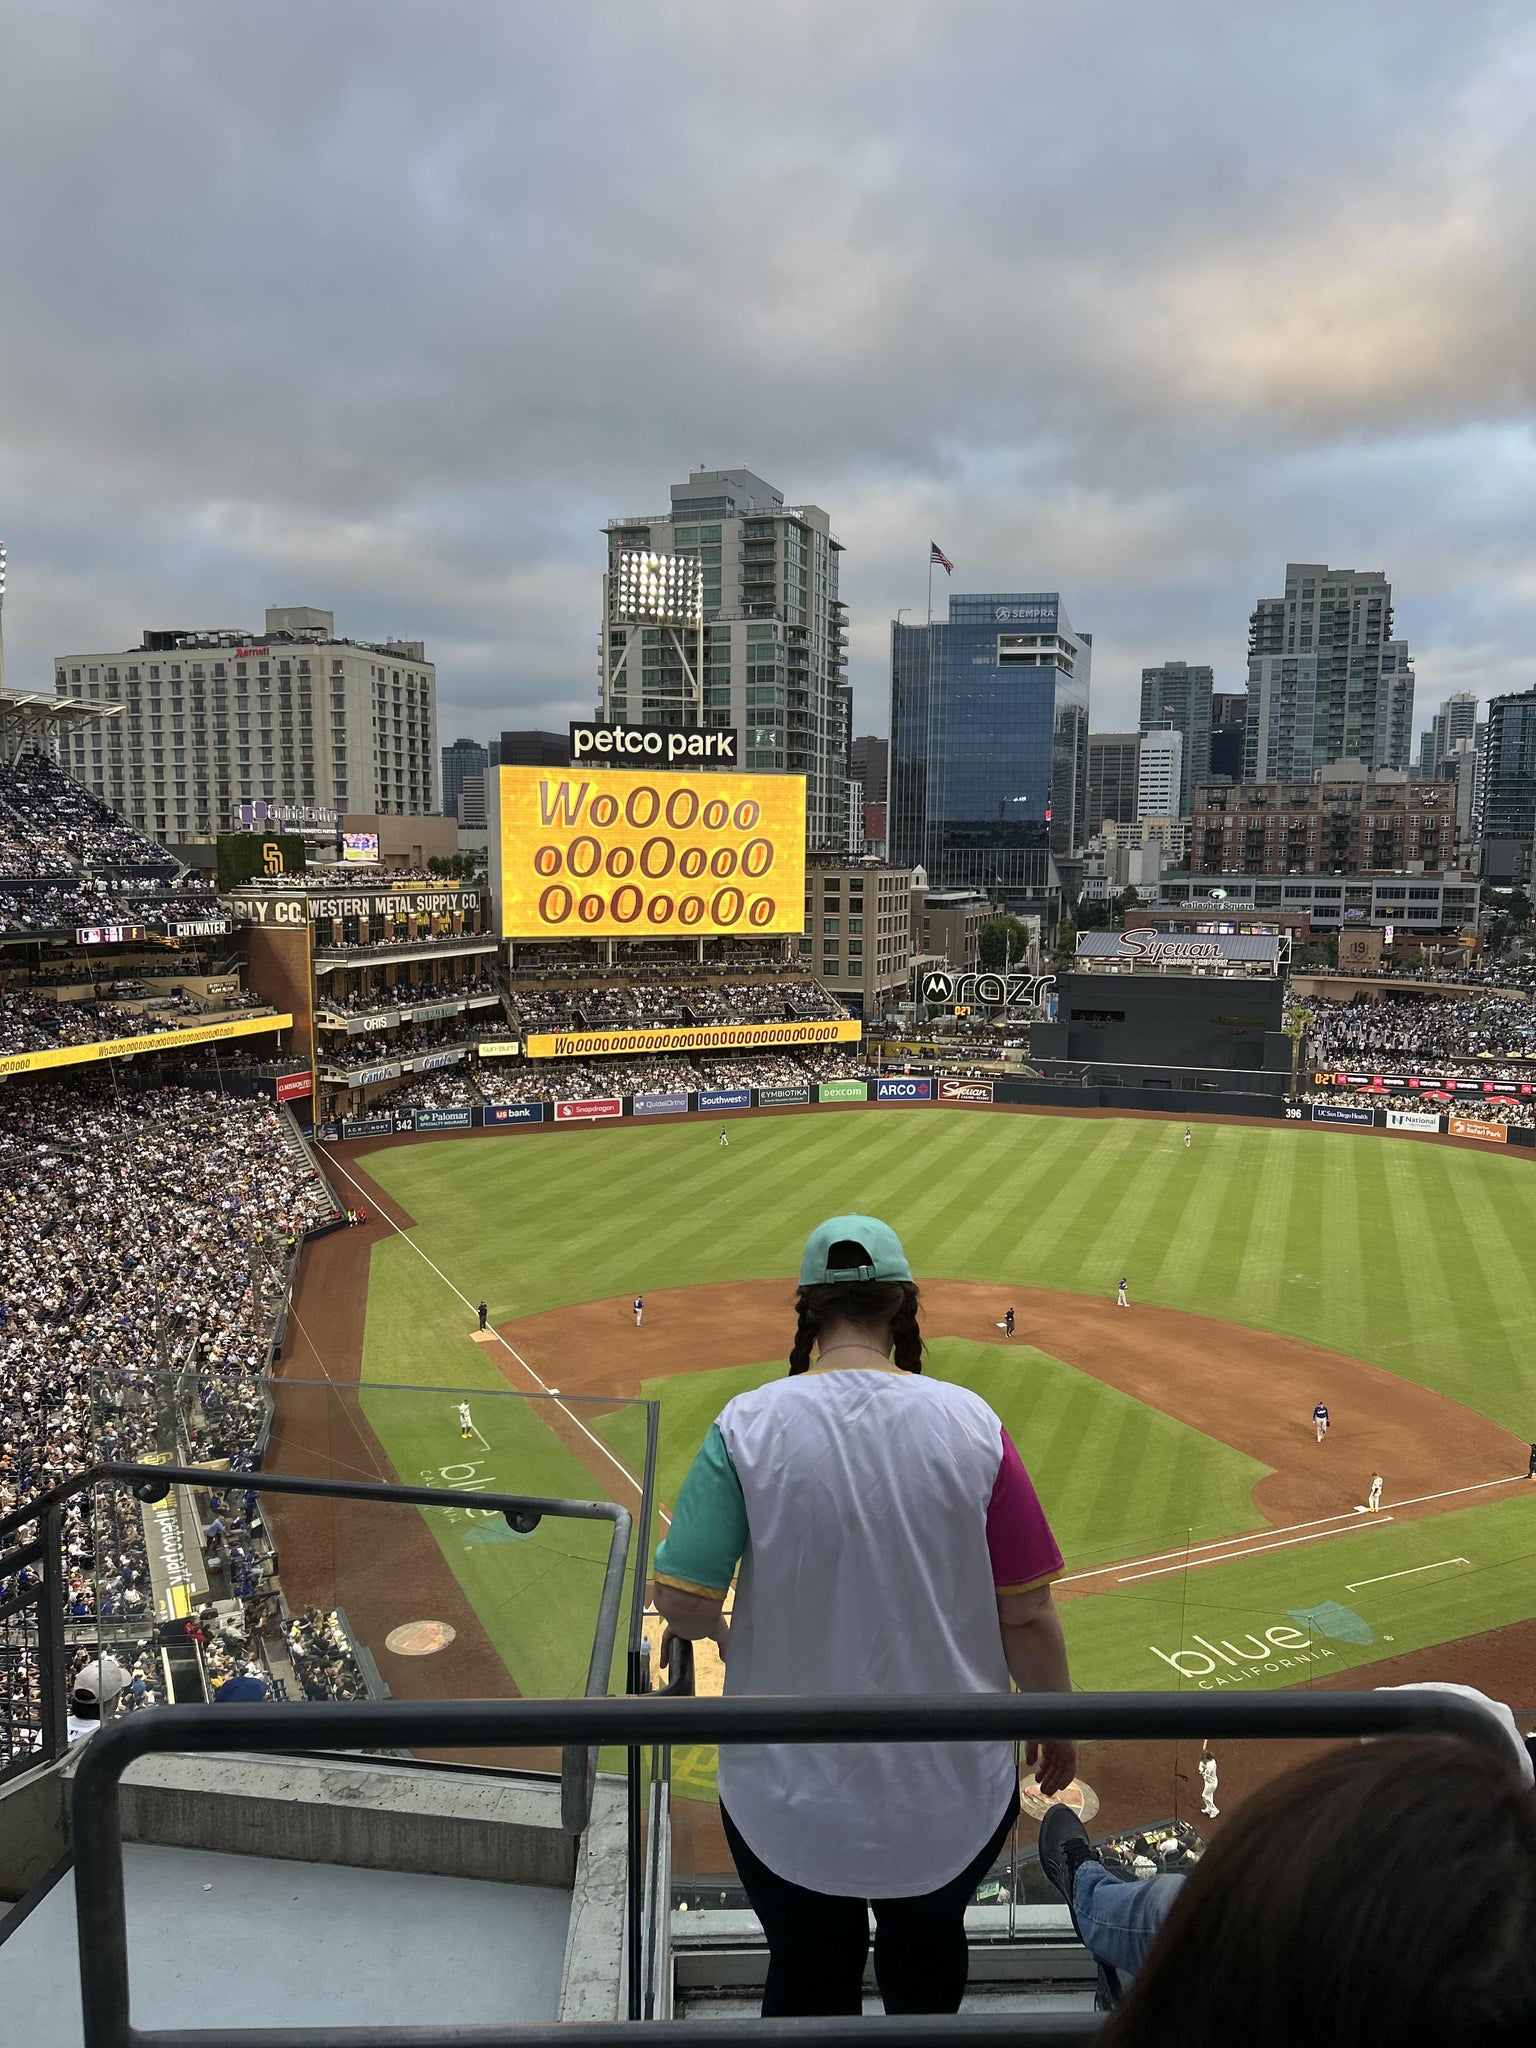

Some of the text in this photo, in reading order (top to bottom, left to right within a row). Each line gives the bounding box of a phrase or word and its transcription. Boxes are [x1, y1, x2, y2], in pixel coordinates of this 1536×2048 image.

[1012, 609, 1055, 618] SEMPRA
[573, 725, 735, 761] petco park
[309, 893, 479, 918] WESTERN METAL SUPPLY CO.
[1180, 901, 1255, 911] Gallagher Square
[176, 921, 226, 936] CUTWATER
[1117, 928, 1224, 965] Sycuan
[1354, 942, 1366, 953] 19
[956, 972, 1056, 1006] razr
[364, 1016, 387, 1030] ORIS
[422, 1053, 452, 1070] Canel's
[359, 1066, 393, 1084] Canel's
[1315, 1073, 1335, 1084] 0:27
[761, 1089, 807, 1099] CYMBIOTIKA
[879, 1083, 917, 1096] ARCO
[942, 1081, 988, 1099] Sycuan
[646, 1099, 685, 1109] QuidelOrtho
[701, 1095, 741, 1105] Southwest
[508, 1107, 530, 1118] bank
[575, 1104, 615, 1114] Snapdragon
[1285, 1108, 1302, 1119] 396
[431, 1112, 468, 1121] Palomar
[1336, 1111, 1351, 1119] Diego
[1351, 1112, 1368, 1120] Health
[1405, 1116, 1436, 1125] National
[396, 1119, 413, 1131] 342
[1466, 1127, 1502, 1138] Safari Park
[1148, 1625, 1313, 1678] blue
[1198, 1648, 1335, 1690] CALIFORNIA
